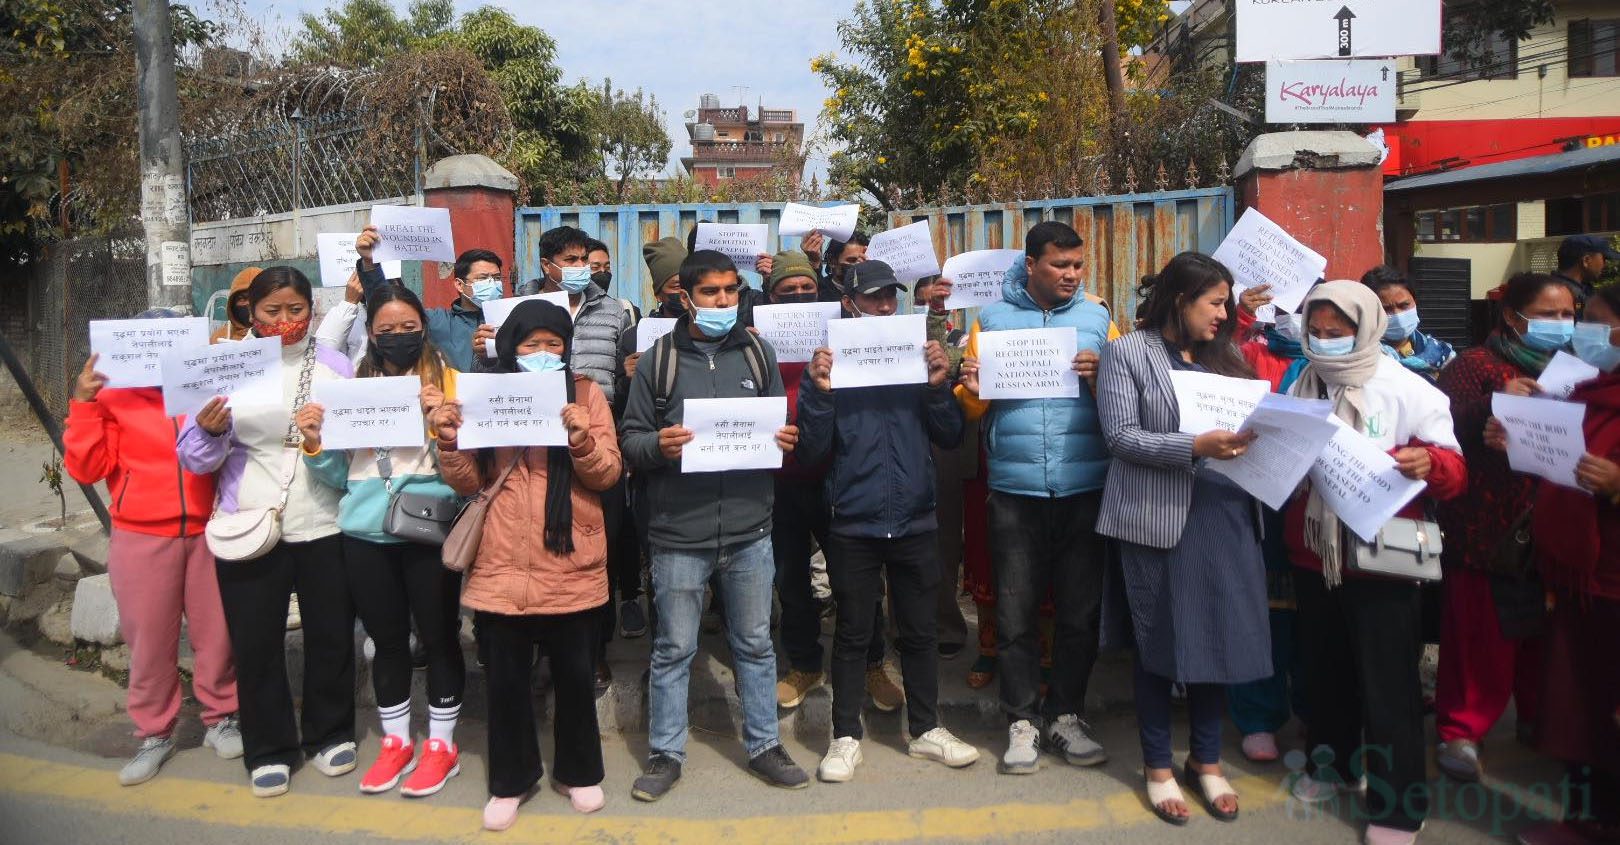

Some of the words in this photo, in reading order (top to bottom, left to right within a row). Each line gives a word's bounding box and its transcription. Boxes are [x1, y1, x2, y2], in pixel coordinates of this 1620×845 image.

[1340, 29, 1349, 49] 300
[1280, 77, 1378, 105] Karyalaya
[385, 224, 414, 233] TREAT
[417, 225, 436, 234] THE
[381, 233, 430, 243] WOUNDED
[1257, 226, 1289, 251] RETURN
[394, 243, 431, 252] BATTLE
[112, 330, 136, 340] युद्धमा
[799, 329, 820, 337] USED
[794, 338, 825, 346] SAFELY
[1006, 339, 1029, 347] STOP
[1031, 338, 1048, 346] THE
[841, 347, 861, 357] युद्धमा
[995, 348, 1060, 358] RECRUITMENT
[184, 357, 208, 369] युद्धमा
[1005, 361, 1016, 369] OF
[1020, 360, 1052, 368] NEPALI
[997, 370, 1048, 379] NATIONALS
[1050, 369, 1061, 377] IN
[995, 381, 1034, 389] RUSSIAN
[332, 407, 353, 417] युद्धमा
[493, 405, 533, 415] नेपालीलाई
[716, 429, 752, 439] नेपालीलाई
[1332, 456, 1344, 468] OF
[1346, 468, 1362, 482] THE
[1349, 456, 1365, 470] THE
[1367, 470, 1391, 492] BODY
[1325, 474, 1347, 498] NEPAL
[1358, 491, 1371, 503] TO
